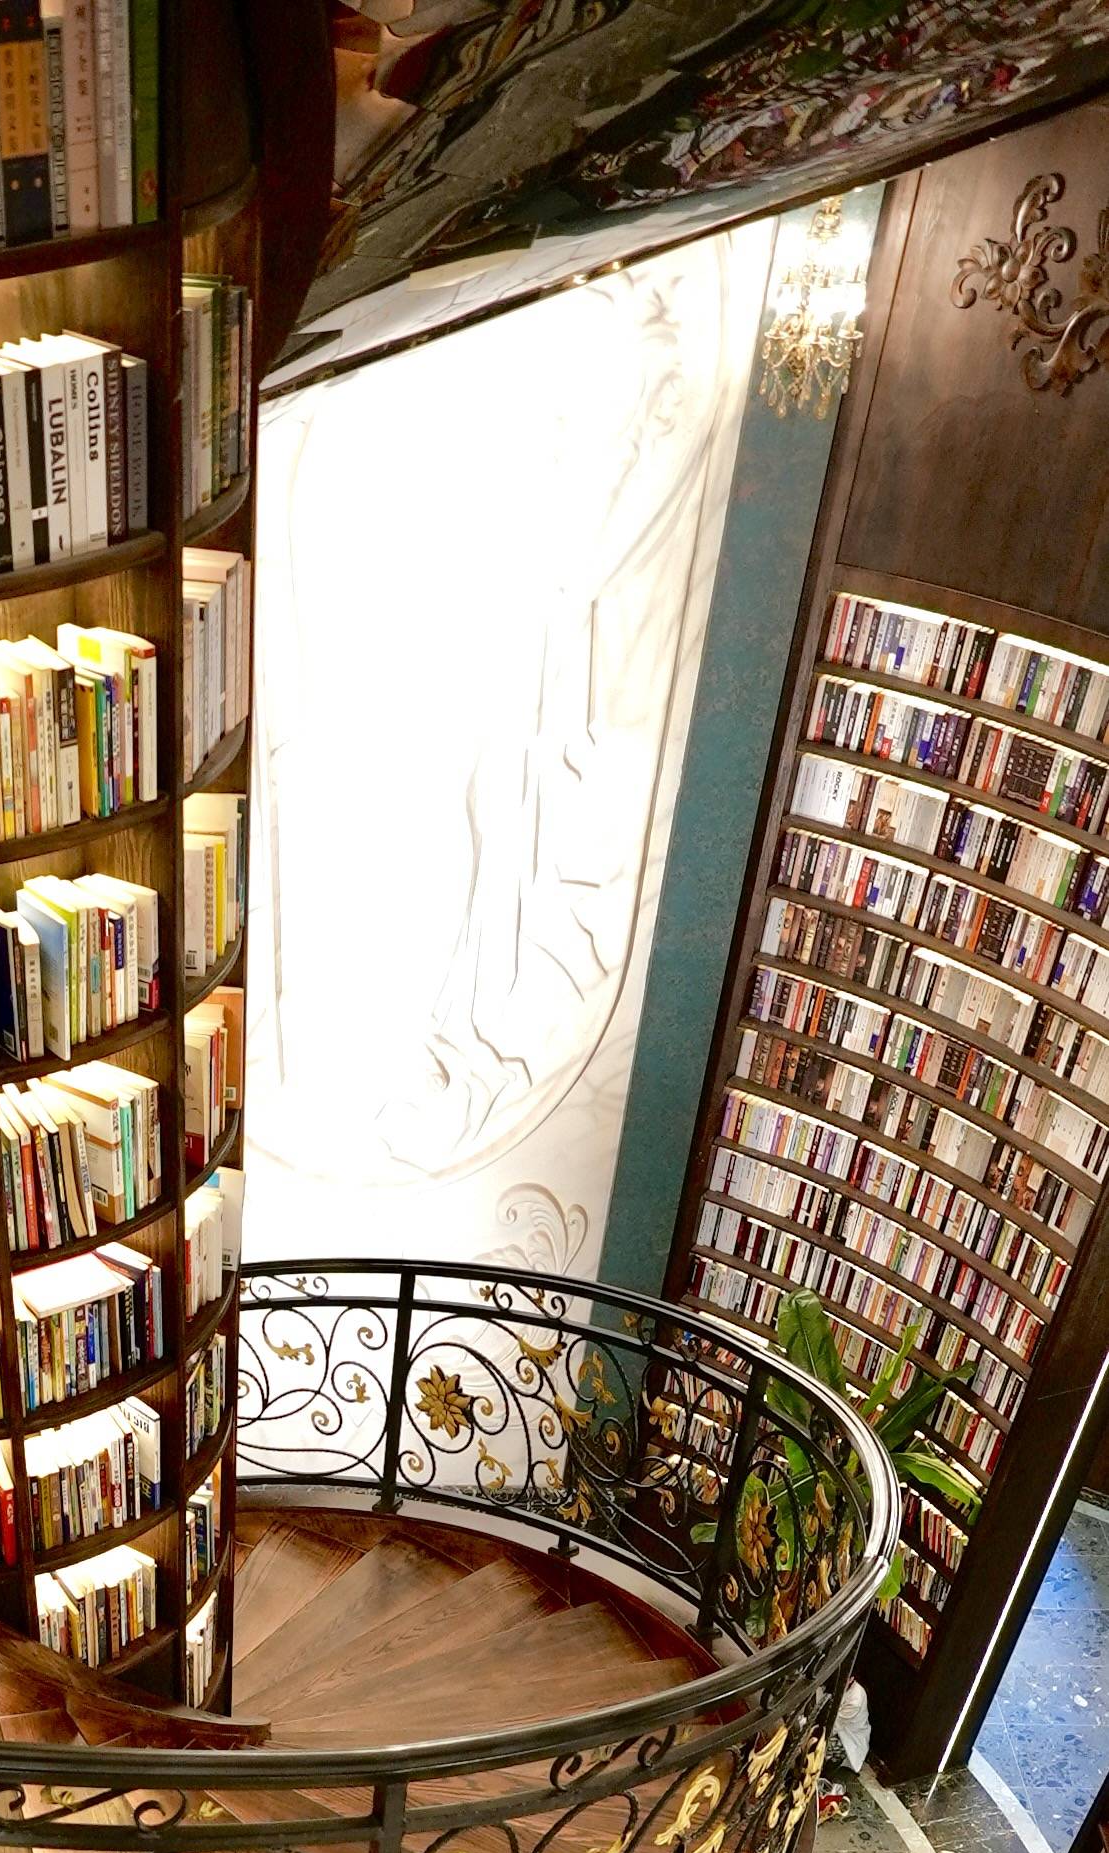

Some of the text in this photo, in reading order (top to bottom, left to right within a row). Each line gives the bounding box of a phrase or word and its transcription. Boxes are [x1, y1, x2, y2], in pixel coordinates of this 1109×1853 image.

[48, 397, 67, 506] LUBALIN
[86, 371, 101, 462] Collins
[106, 359, 123, 537] SIDNEY SHELDON
[829, 770, 842, 804] ROCKY
